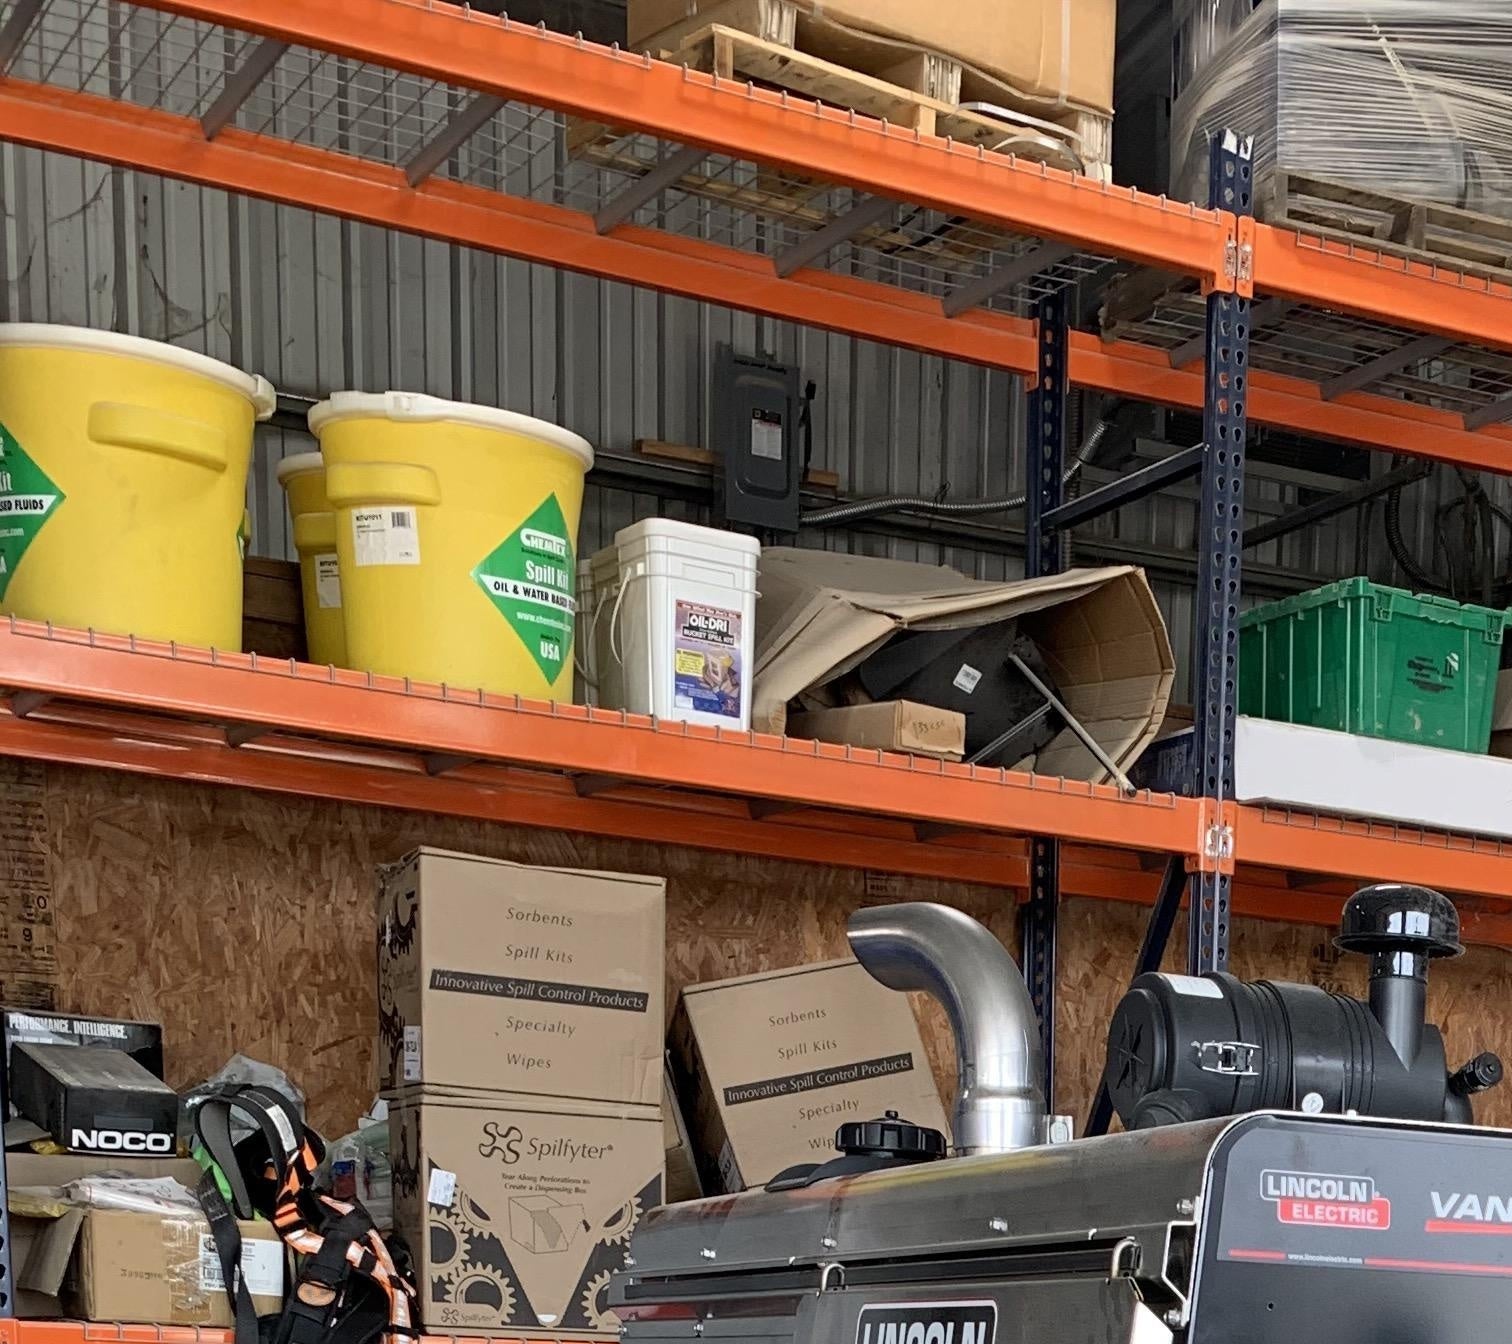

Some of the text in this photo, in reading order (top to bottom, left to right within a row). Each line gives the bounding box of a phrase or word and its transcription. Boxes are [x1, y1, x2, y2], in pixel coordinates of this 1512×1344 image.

[15, 499, 44, 511] FLUIDS
[525, 559, 556, 587] Spill
[493, 580, 510, 594] OIL
[512, 584, 519, 595] &
[522, 585, 551, 601] WATER
[539, 640, 560, 661] USA
[505, 907, 574, 927] Sorbents
[505, 944, 574, 964] Spill Kits
[435, 974, 644, 1009] Innovative Spill Control Products
[9, 1013, 72, 1034] PERFORMANCE.
[73, 1020, 128, 1040] INTELLIGENCE.
[505, 1016, 576, 1038] Specialty
[768, 1008, 827, 1028] Sorbents
[777, 1040, 837, 1060] Spill Kits
[506, 1052, 551, 1070] Wipes
[728, 1057, 910, 1103] Innovative Spill Control Products
[798, 1098, 860, 1121] Specialty
[71, 1128, 171, 1152] NOCO
[808, 1137, 836, 1153] Wip
[1267, 1175, 1367, 1202] LINCOLN
[1292, 1203, 1378, 1224] ELECTRIC
